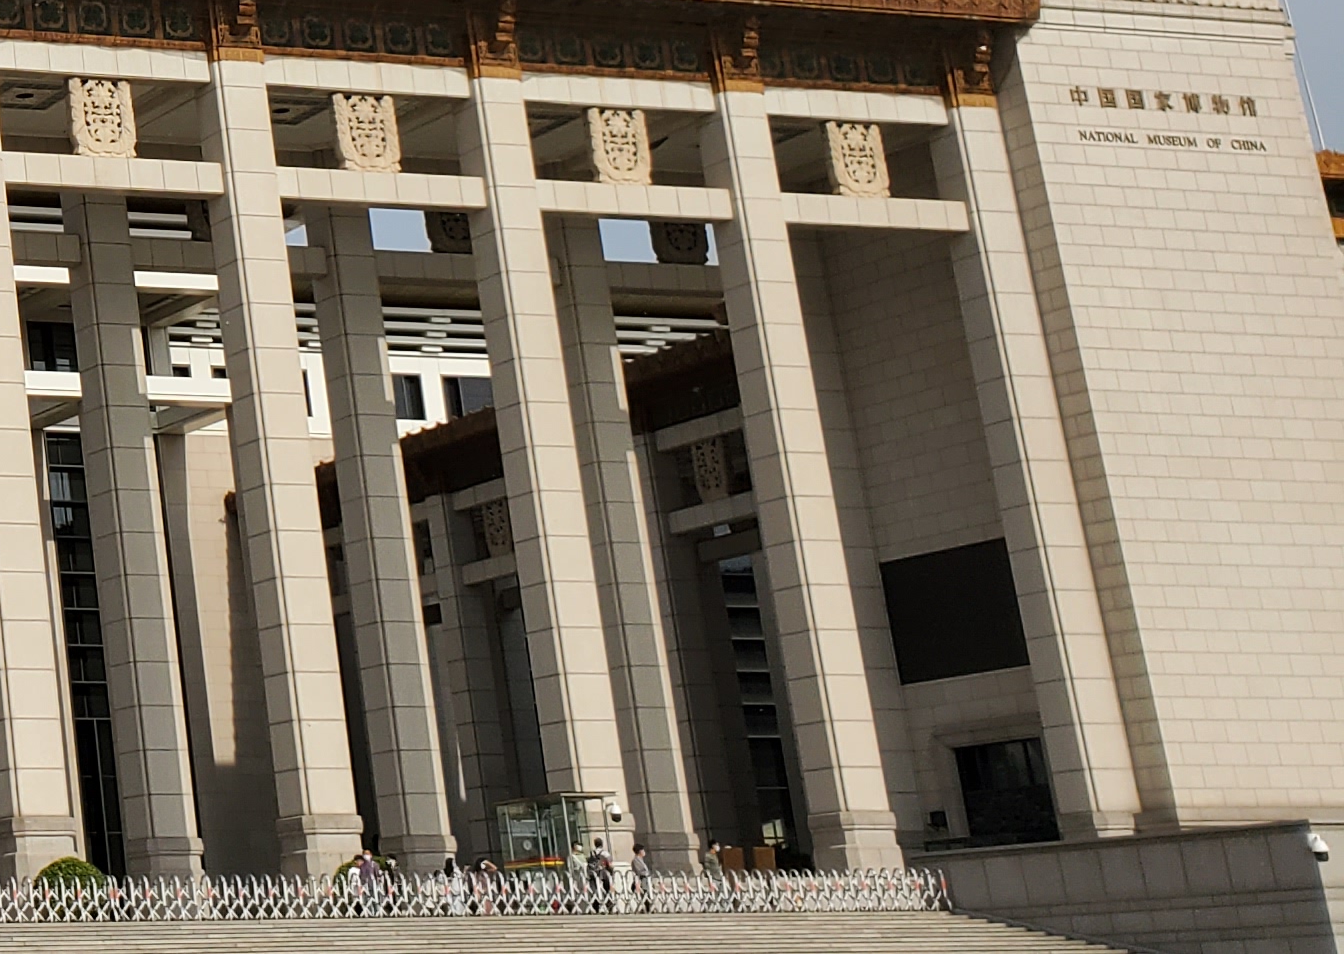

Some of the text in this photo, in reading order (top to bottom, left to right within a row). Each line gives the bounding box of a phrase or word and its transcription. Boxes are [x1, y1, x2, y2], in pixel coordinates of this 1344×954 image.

[1069, 85, 1257, 117] 中国国家博物馆
[1078, 130, 1267, 153] NATIONAL MUSEUM OF CHINA
